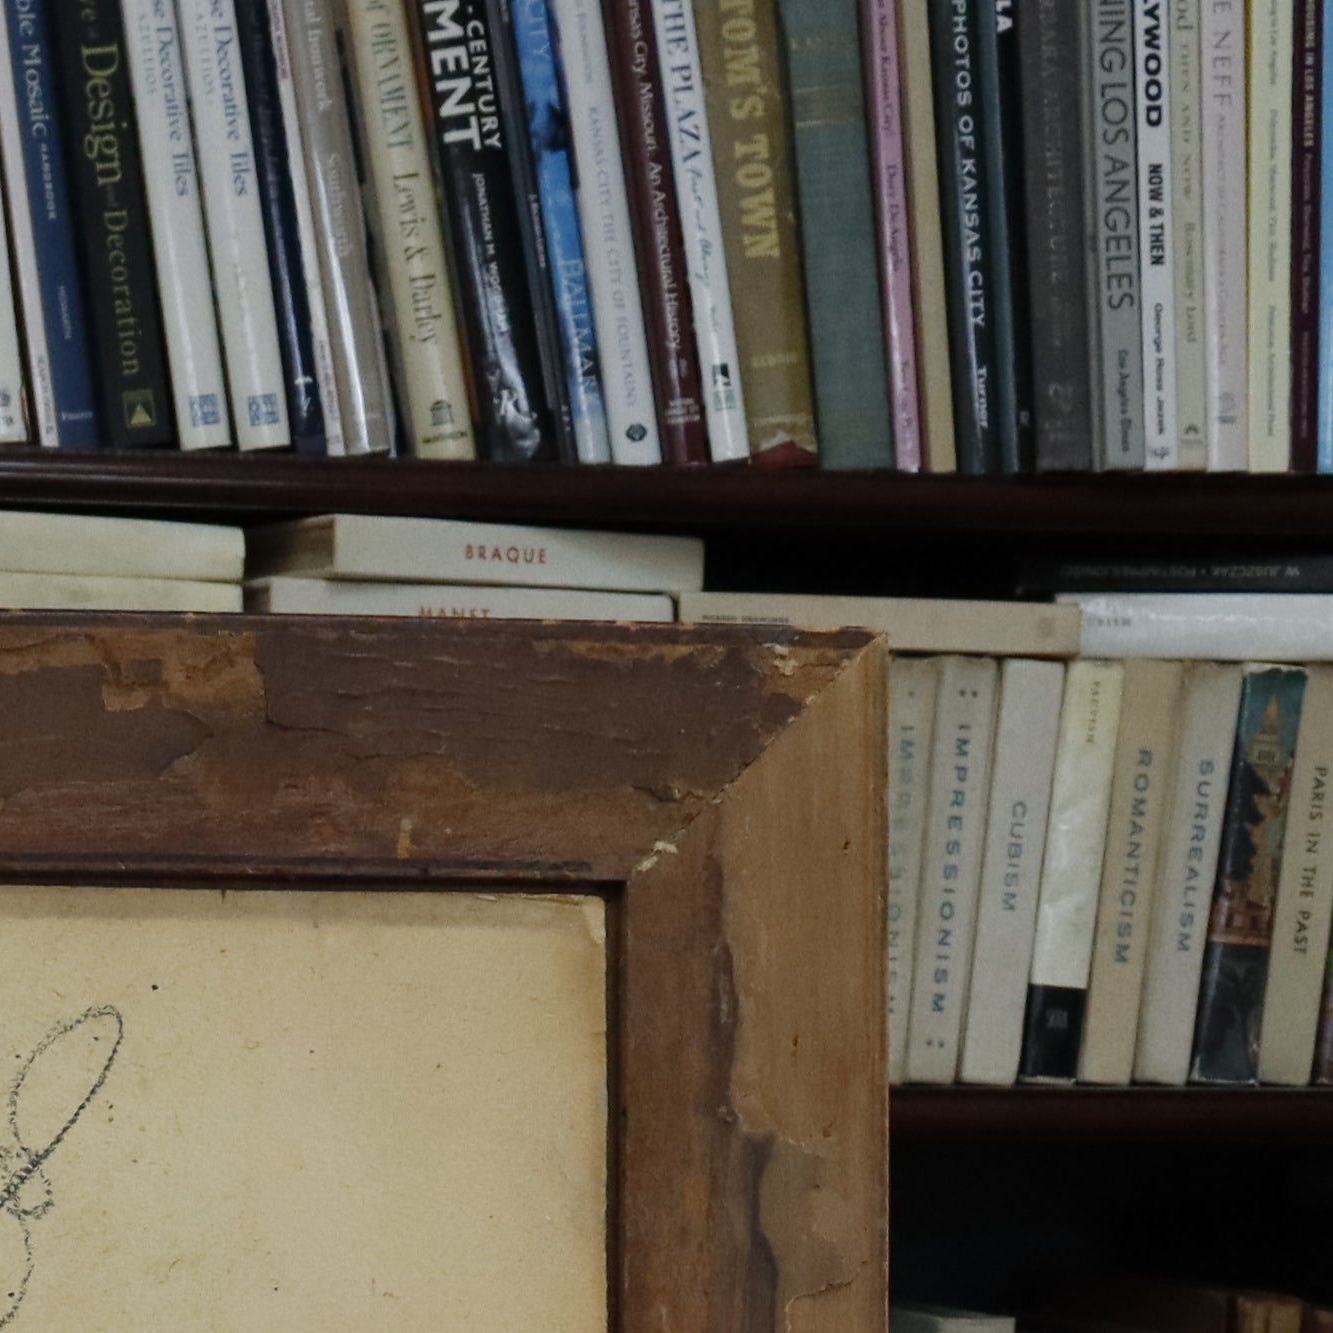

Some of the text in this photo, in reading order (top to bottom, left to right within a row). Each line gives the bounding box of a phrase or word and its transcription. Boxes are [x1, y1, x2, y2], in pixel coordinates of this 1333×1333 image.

[155, 26, 197, 198] Decorative Tiles
[212, 26, 255, 198] Decorative Tiles
[424, 0, 480, 150] MENT
[670, 63, 701, 163] PLAZA
[1213, 30, 1234, 105] NEFF
[1303, 51, 1316, 148] IN LOS ANGELES
[19, 43, 57, 221] Mosaic HANDBOOK
[586, 106, 609, 166] KANSAS
[952, 0, 986, 328] PHOTOS OF KANSAS CITY
[1181, 101, 1192, 143] AND
[79, 43, 144, 378] Design Decoration
[371, 24, 439, 345] ORNAMENT Lewis & Darley
[472, 174, 496, 241] JONATHAN
[594, 170, 611, 207] CITY
[648, 163, 664, 186] An
[734, 133, 780, 260] TOWN
[1101, 82, 1134, 312] LOS ANGELES
[1146, 163, 1166, 266] NOW & THEN
[1181, 153, 1193, 199] NOW
[599, 214, 616, 241] THE
[604, 249, 622, 285] CITY
[651, 189, 679, 289] Architectural
[1183, 221, 1198, 300] Rosemary
[561, 260, 598, 398] HALLMARK
[610, 290, 626, 312] OF
[663, 292, 682, 350] History
[1151, 302, 1164, 352] George
[613, 315, 637, 408] FOUNTAINS
[976, 366, 990, 428] Turner
[464, 543, 548, 566] BRAQUE
[419, 605, 491, 619] MANET
[931, 724, 973, 1015] IMPRESSIONISM
[1001, 800, 1029, 913] CUBISM
[1114, 747, 1154, 966] ROMANTICISM
[1176, 758, 1216, 955] SURREALISM
[1292, 765, 1330, 956] PARIS IN THE PAST
